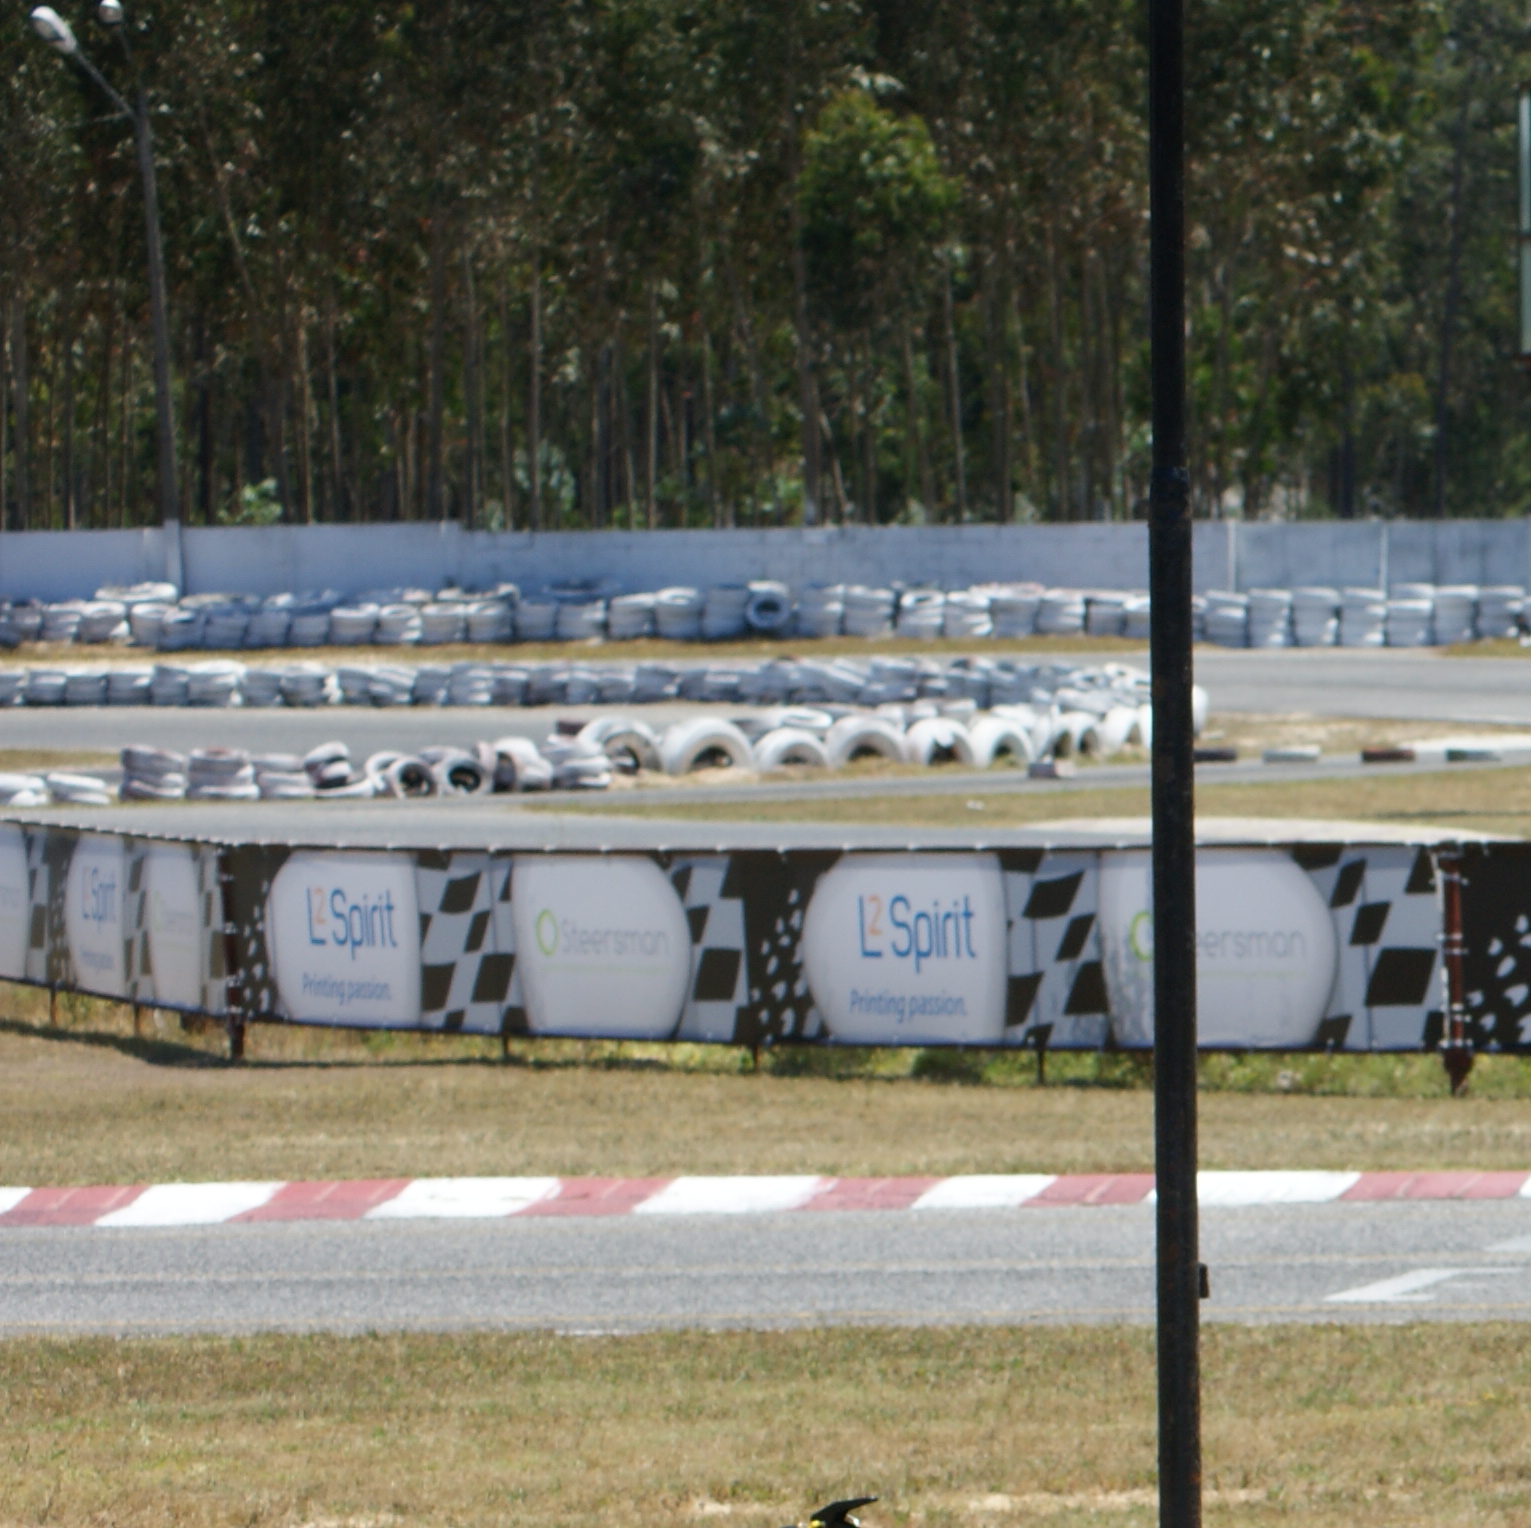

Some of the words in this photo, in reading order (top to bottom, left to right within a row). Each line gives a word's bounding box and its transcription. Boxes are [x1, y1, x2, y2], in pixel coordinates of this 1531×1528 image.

[329, 887, 398, 961] Spirit
[561, 918, 670, 956] Steersman
[890, 894, 977, 973] Spirit
[1196, 929, 1306, 959] ersman
[848, 988, 906, 1024] Printing
